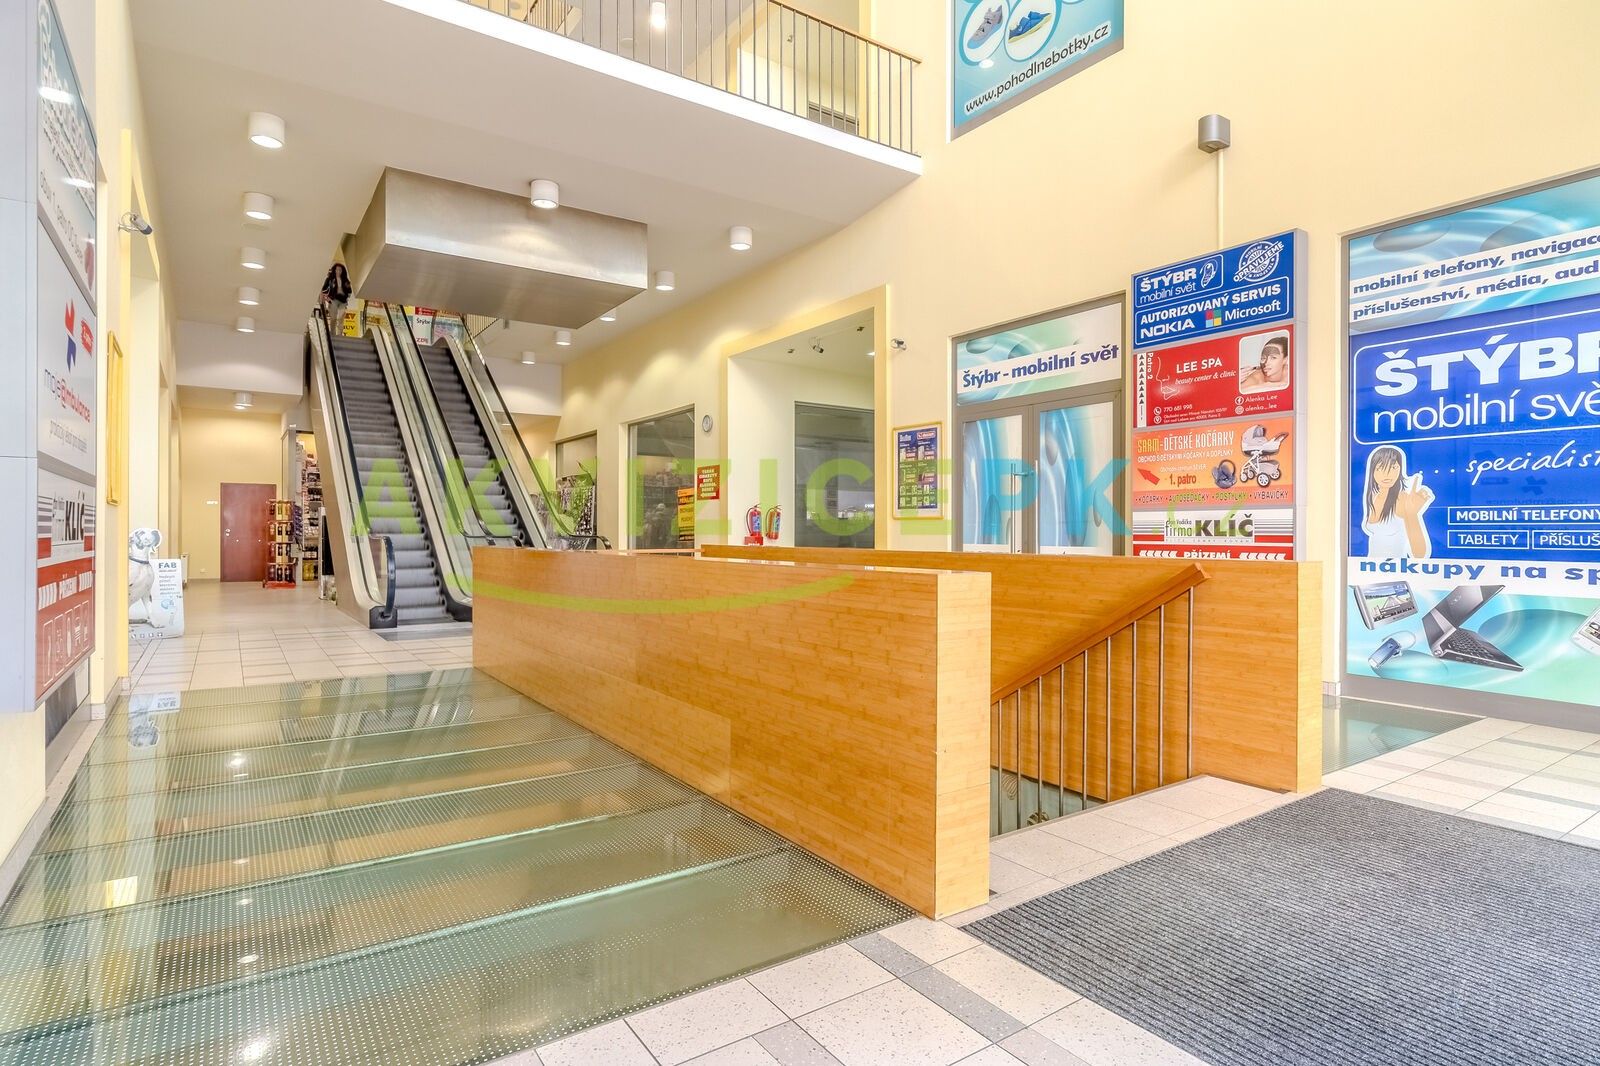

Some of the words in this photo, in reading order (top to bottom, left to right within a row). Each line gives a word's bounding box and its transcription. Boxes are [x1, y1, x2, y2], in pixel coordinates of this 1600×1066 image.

[965, 24, 1109, 112] www.pohodlnebotky.cz
[1233, 241, 1284, 282] OPRAVUJEME
[1140, 267, 1197, 292] ŠTÝBR
[1353, 270, 1418, 294] mobilní
[1423, 256, 1505, 280] telefony,
[1140, 287, 1173, 304] mobilní
[1175, 281, 1197, 295] svět
[1141, 293, 1229, 325] AUTORIZOVANÝ
[1232, 283, 1281, 304] SERVIS
[1353, 286, 1471, 320] příslušenství,
[1476, 274, 1549, 296] média,
[1140, 318, 1195, 339] NOKIA
[1225, 300, 1281, 321] Microsoft
[962, 370, 1000, 389] Štýbr
[1011, 351, 1076, 379] mobilní
[1080, 343, 1119, 366] svět
[1175, 376, 1194, 385] beauty
[1194, 374, 1212, 382] center
[1220, 369, 1237, 379] clinic
[1176, 361, 1198, 374] LEE
[1201, 356, 1222, 370] SPA
[1374, 389, 1521, 434] mobilní
[1195, 429, 1235, 448] KOČÁRKY
[1169, 473, 1175, 485] 1.
[1177, 473, 1197, 487] patro
[64, 489, 85, 541] KLÍČ
[1165, 520, 1193, 537] firma
[1195, 513, 1254, 537] KLÍČ
[1456, 507, 1518, 521] MOBILNÍ
[1458, 533, 1519, 546] TABLETY
[1183, 549, 1231, 559] PŘÍZEMÍ
[1360, 557, 1486, 581] nákupy
[1500, 564, 1547, 579] na
